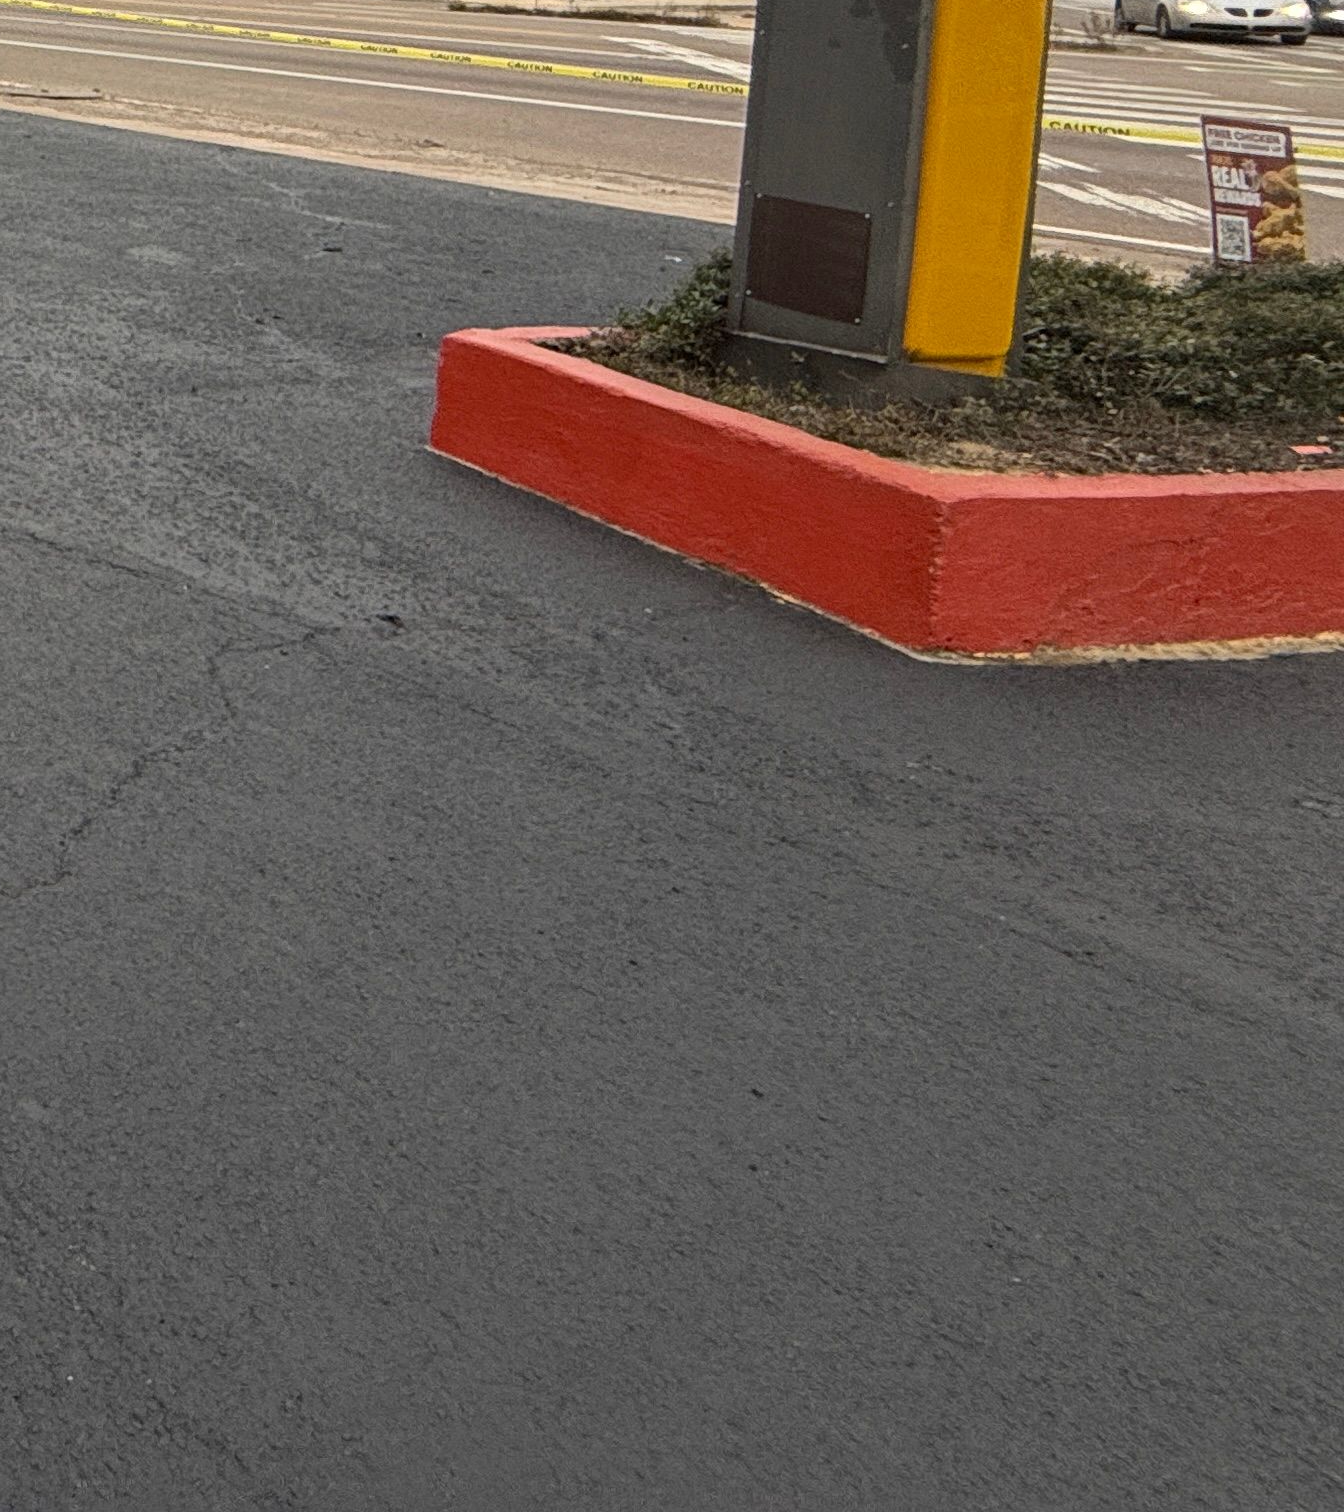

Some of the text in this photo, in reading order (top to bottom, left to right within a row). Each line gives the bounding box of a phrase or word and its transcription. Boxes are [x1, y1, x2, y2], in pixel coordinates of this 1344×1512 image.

[506, 60, 554, 74] CAUTION
[592, 70, 644, 84] CAUTION
[687, 81, 744, 96] CAUTION
[1049, 120, 1130, 137] CAUTION
